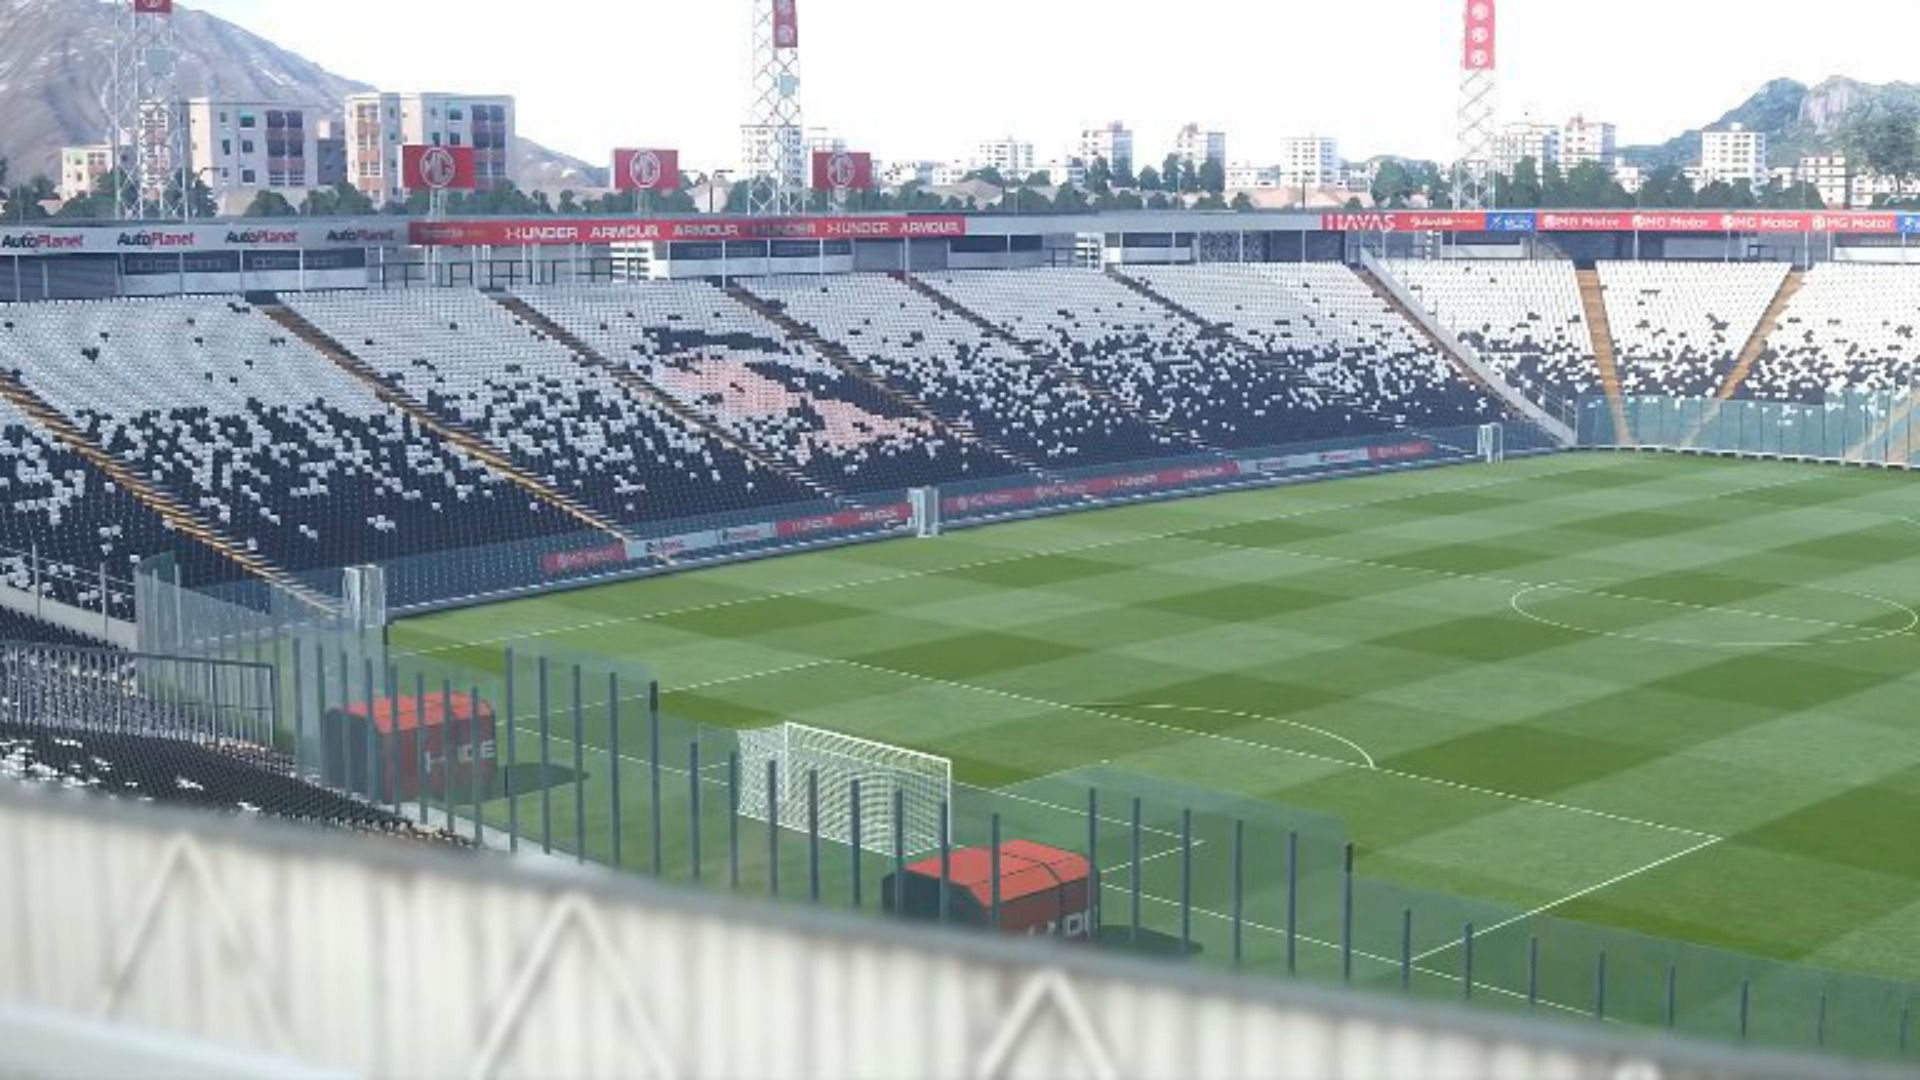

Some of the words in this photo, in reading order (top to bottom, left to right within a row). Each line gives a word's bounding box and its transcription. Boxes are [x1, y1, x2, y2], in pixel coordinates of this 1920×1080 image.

[521, 226, 578, 238] UNDER
[589, 224, 660, 238] ARMOUR
[673, 224, 739, 237] ARMOUR
[841, 221, 889, 234] UNDER
[900, 220, 960, 233] ARMOUR
[1, 234, 84, 249] AutoPlanet
[116, 232, 194, 247] AutoPlanet
[225, 229, 299, 244] AutoPlanet
